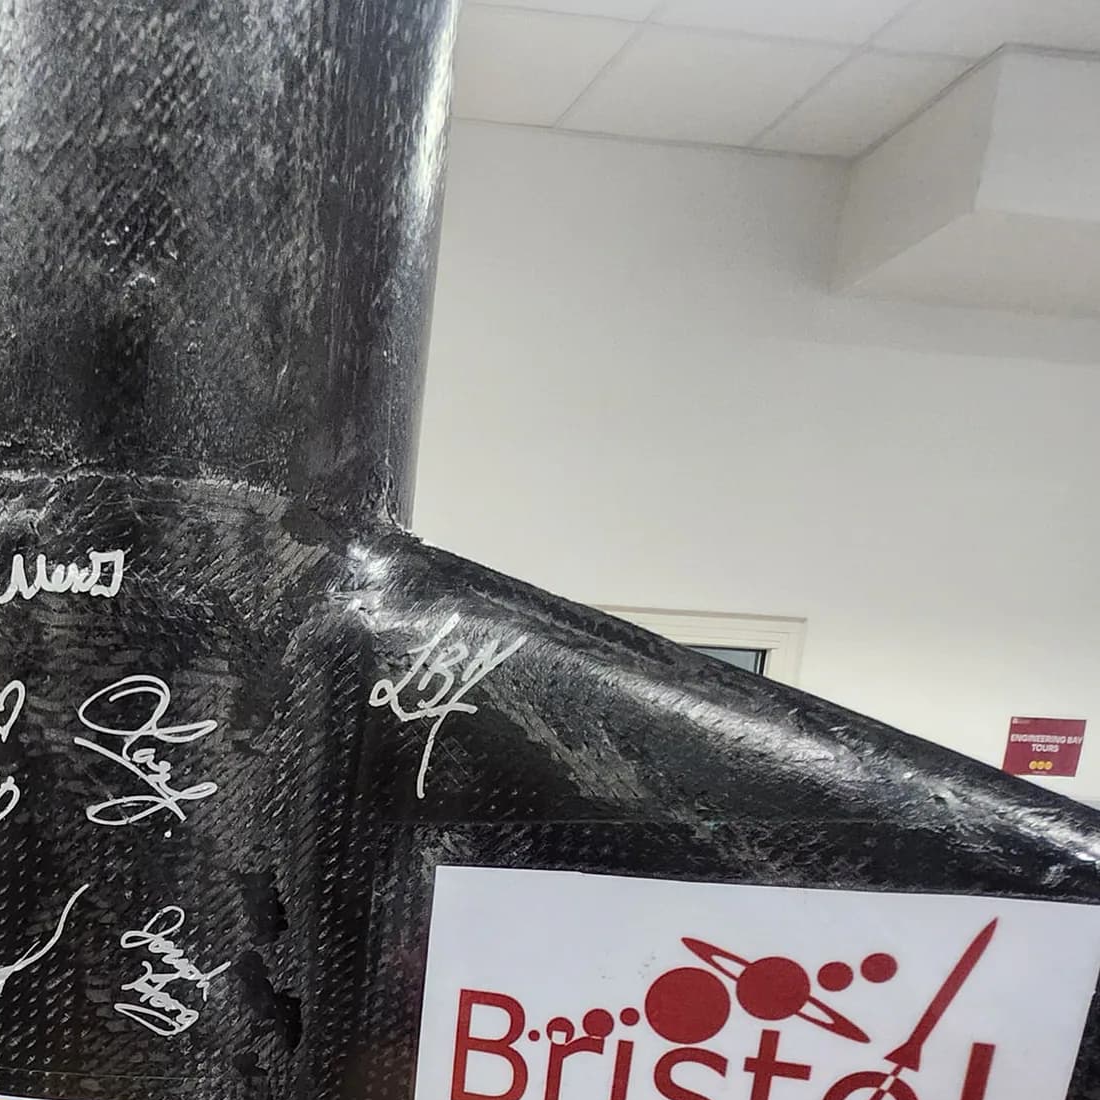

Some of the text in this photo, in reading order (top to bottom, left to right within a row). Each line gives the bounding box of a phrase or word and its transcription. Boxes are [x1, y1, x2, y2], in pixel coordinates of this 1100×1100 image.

[1010, 733, 1083, 744] ENGINEERING BAY
[1031, 743, 1059, 752] TOURS
